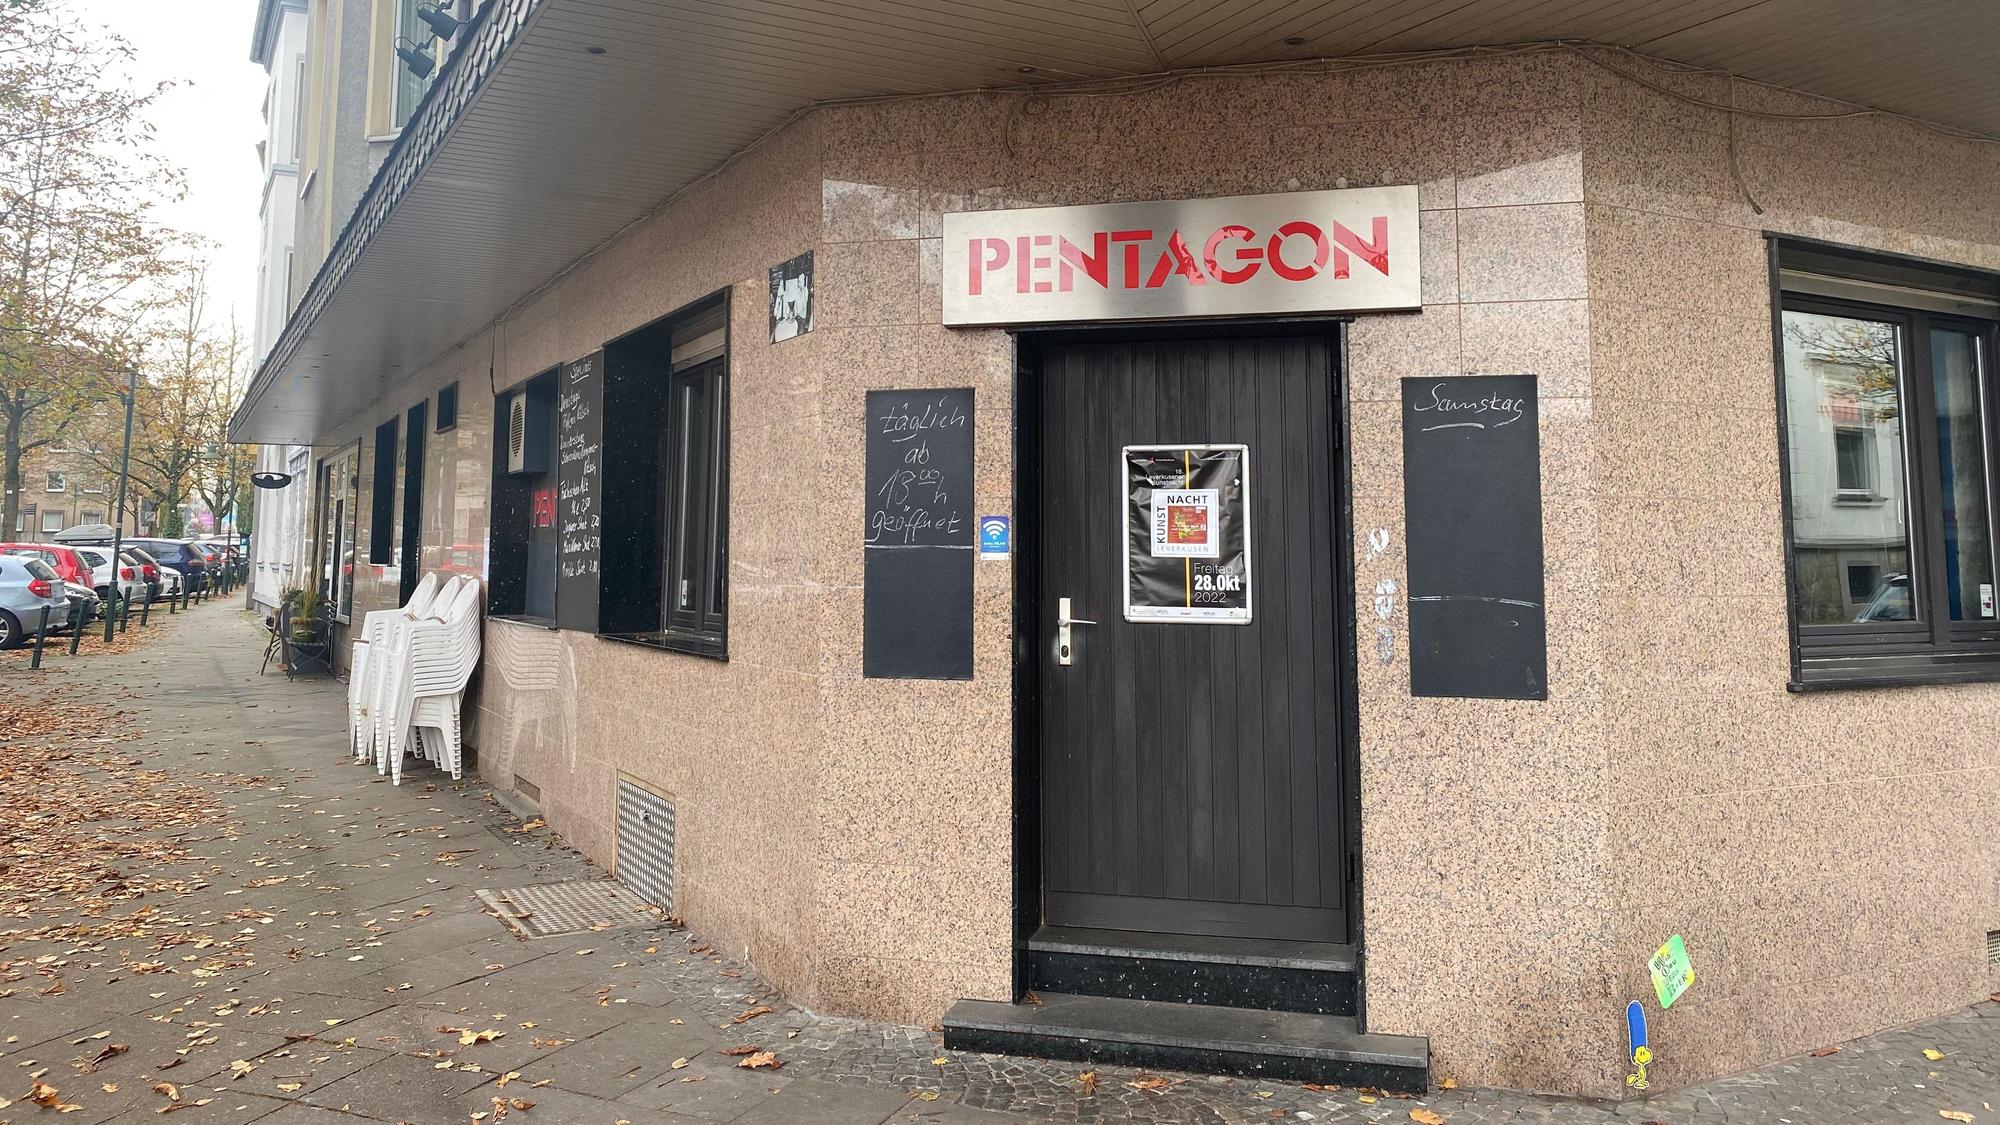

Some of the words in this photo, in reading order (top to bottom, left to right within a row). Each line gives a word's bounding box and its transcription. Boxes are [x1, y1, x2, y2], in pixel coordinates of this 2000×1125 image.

[968, 216, 1389, 296] PENTAGON
[1414, 382, 1525, 428] Samstag
[880, 396, 965, 442] täglich
[904, 440, 930, 464] ab
[1167, 495, 1208, 504] NACHT
[866, 504, 961, 543] geöffnet
[1156, 506, 1166, 544] KUNST
[1156, 545, 1209, 553] LEVERKUSEN
[1193, 562, 1233, 577] Freitag
[1193, 574, 1241, 591] 28.Okt
[1194, 591, 1227, 603] 2022
